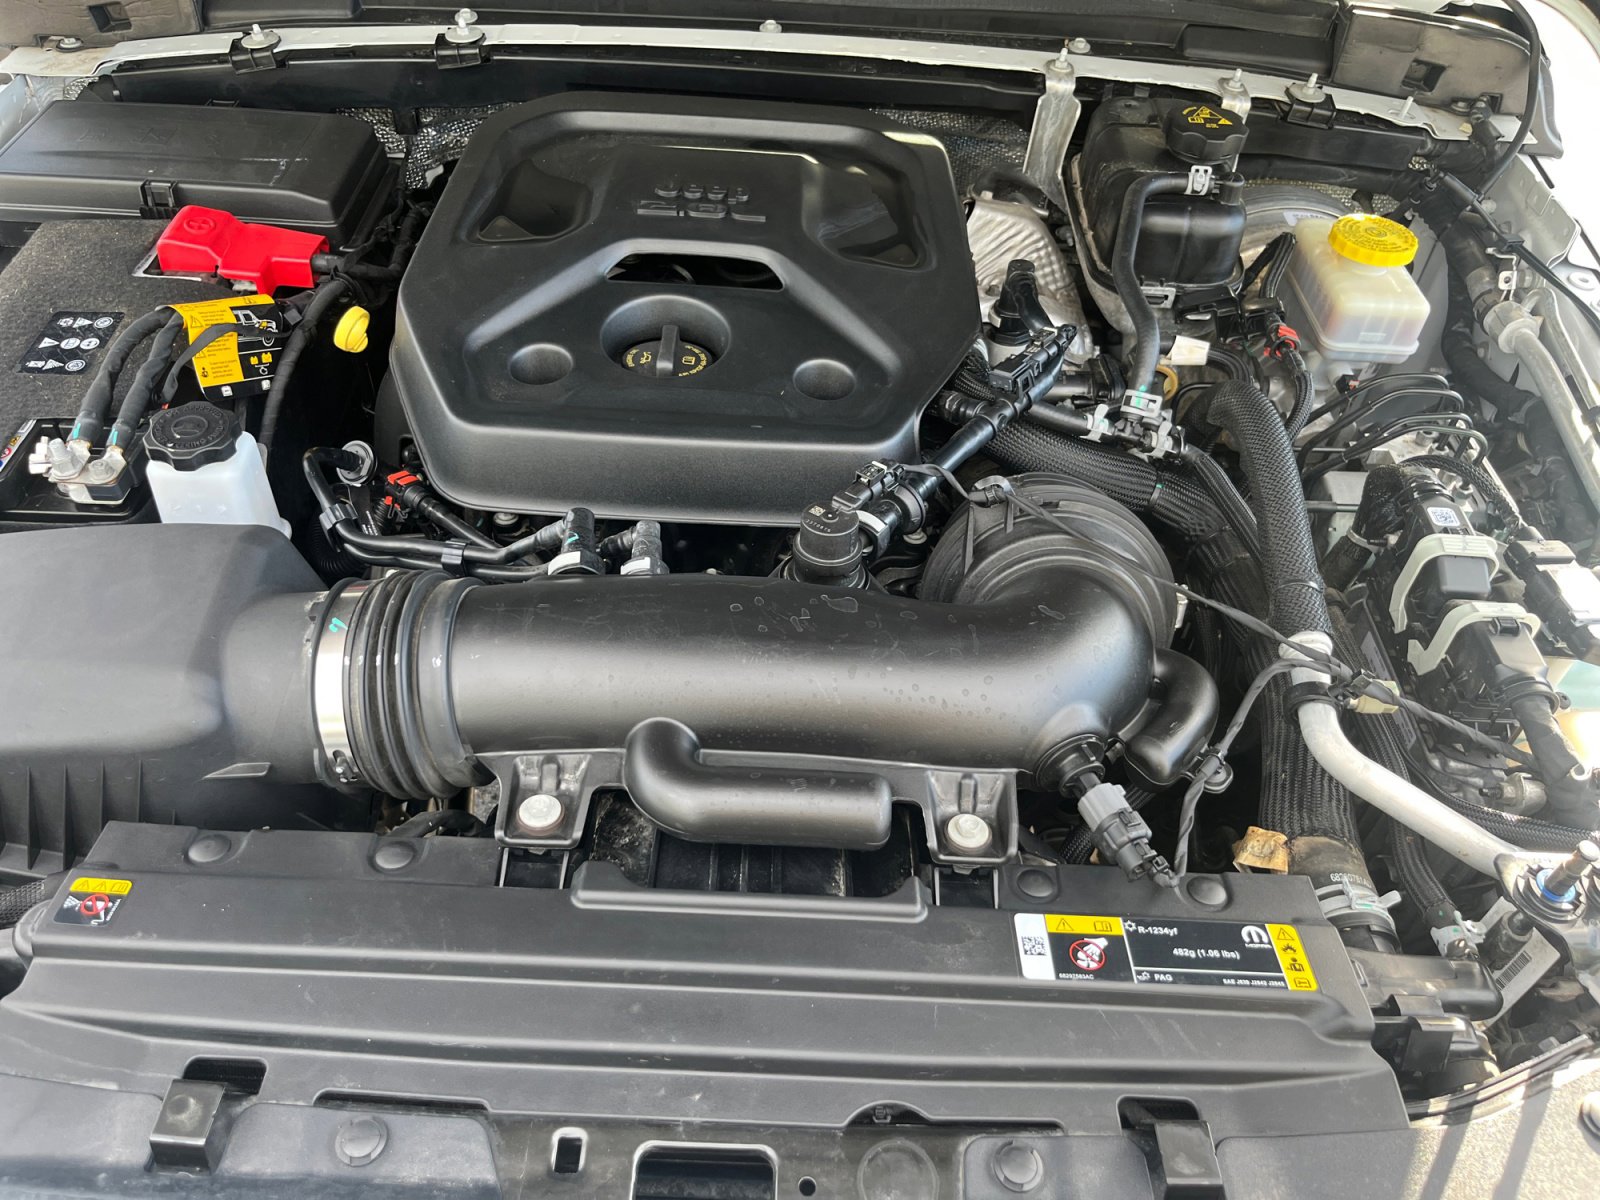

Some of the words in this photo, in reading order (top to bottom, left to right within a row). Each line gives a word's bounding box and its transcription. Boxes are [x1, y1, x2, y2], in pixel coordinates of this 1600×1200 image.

[653, 181, 749, 205] Jeep
[1138, 926, 1178, 937] R-1234yf
[1173, 947, 1196, 959] 482g
[1197, 949, 1220, 959] (1.06
[1221, 950, 1240, 960] lbs)
[1154, 973, 1173, 982] PAG
